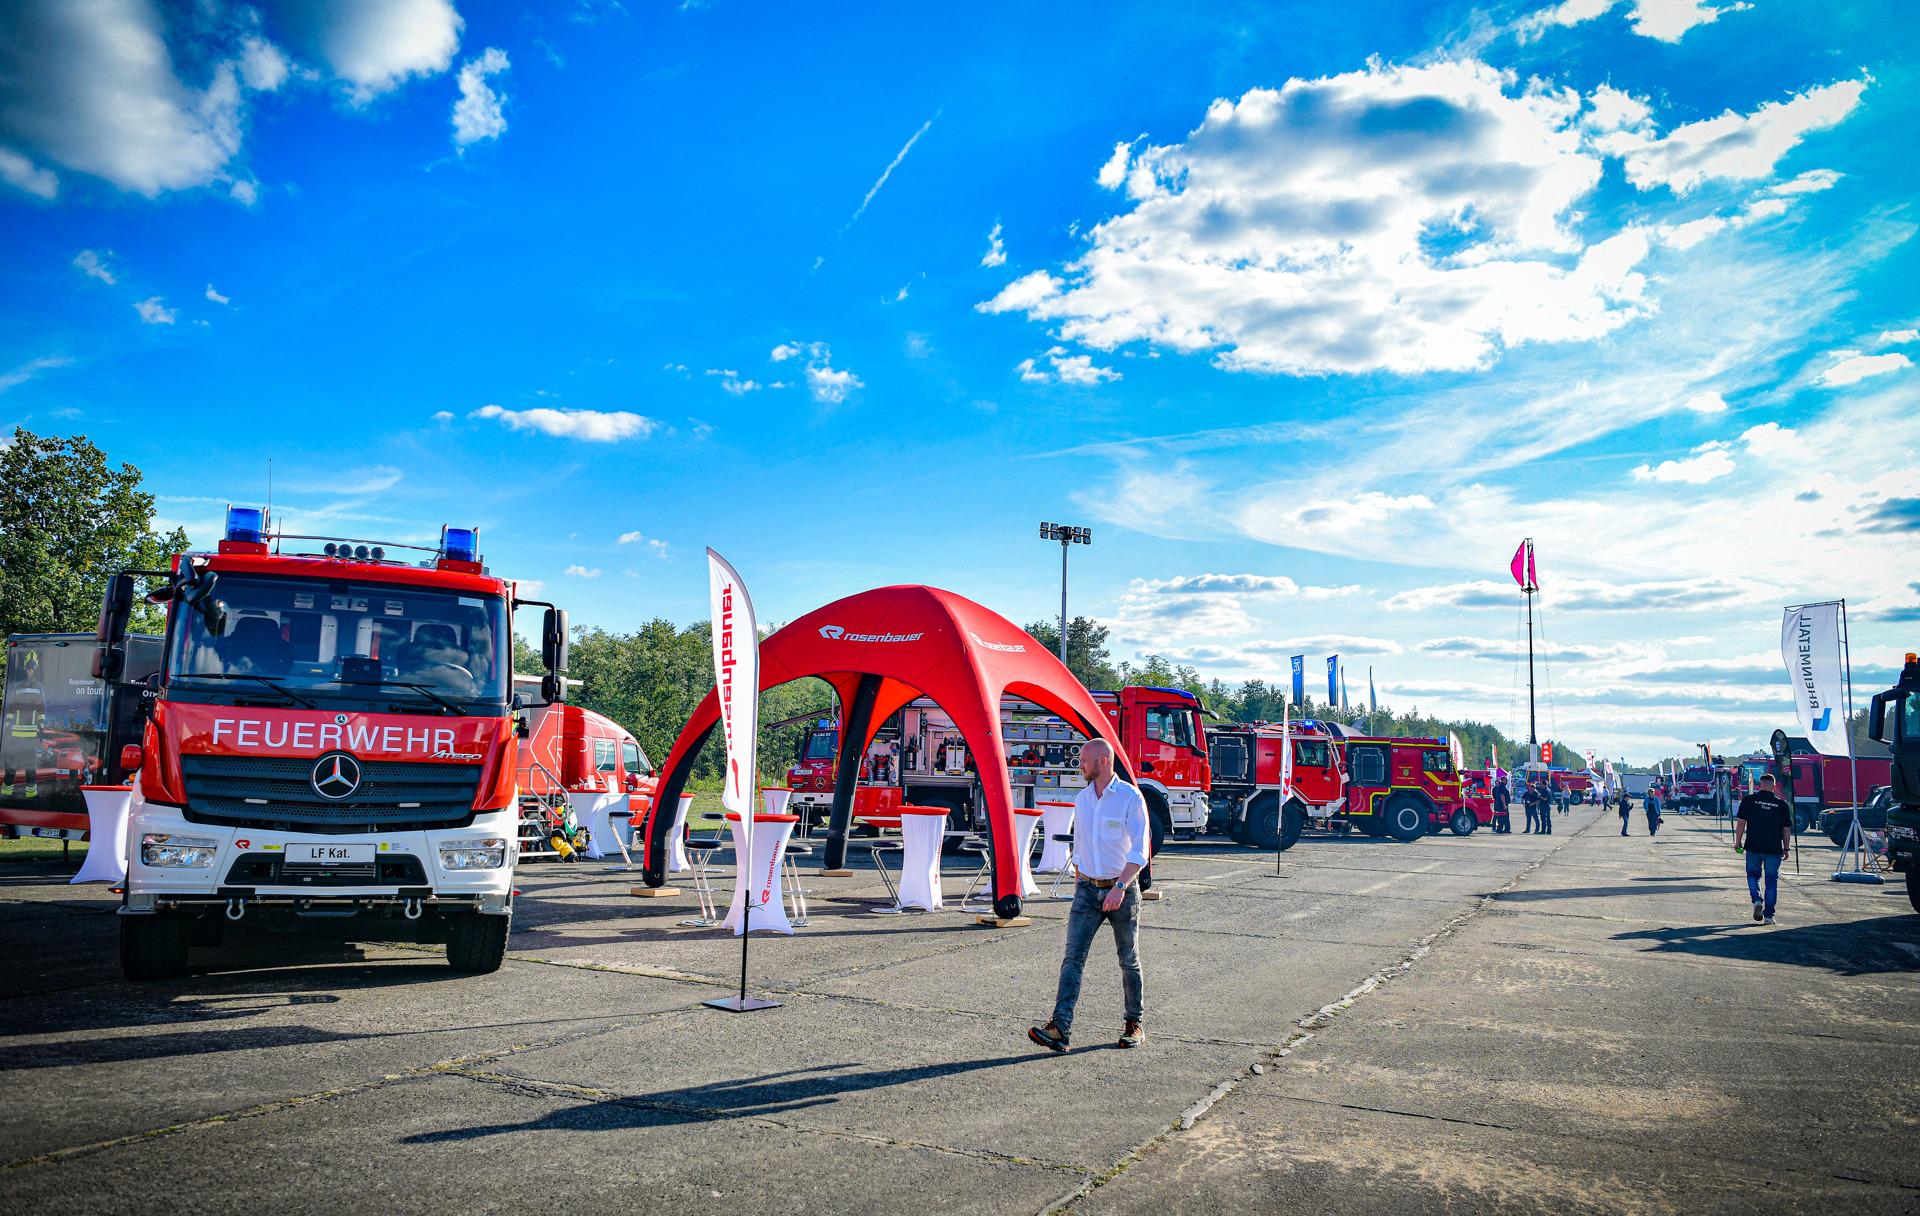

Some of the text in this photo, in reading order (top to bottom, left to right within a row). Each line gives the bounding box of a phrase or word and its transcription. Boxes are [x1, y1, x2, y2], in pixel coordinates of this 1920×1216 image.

[843, 632, 924, 643] rosenbauer
[212, 718, 456, 753] FEUERWEHR
[311, 848, 350, 859] LF Kat.
